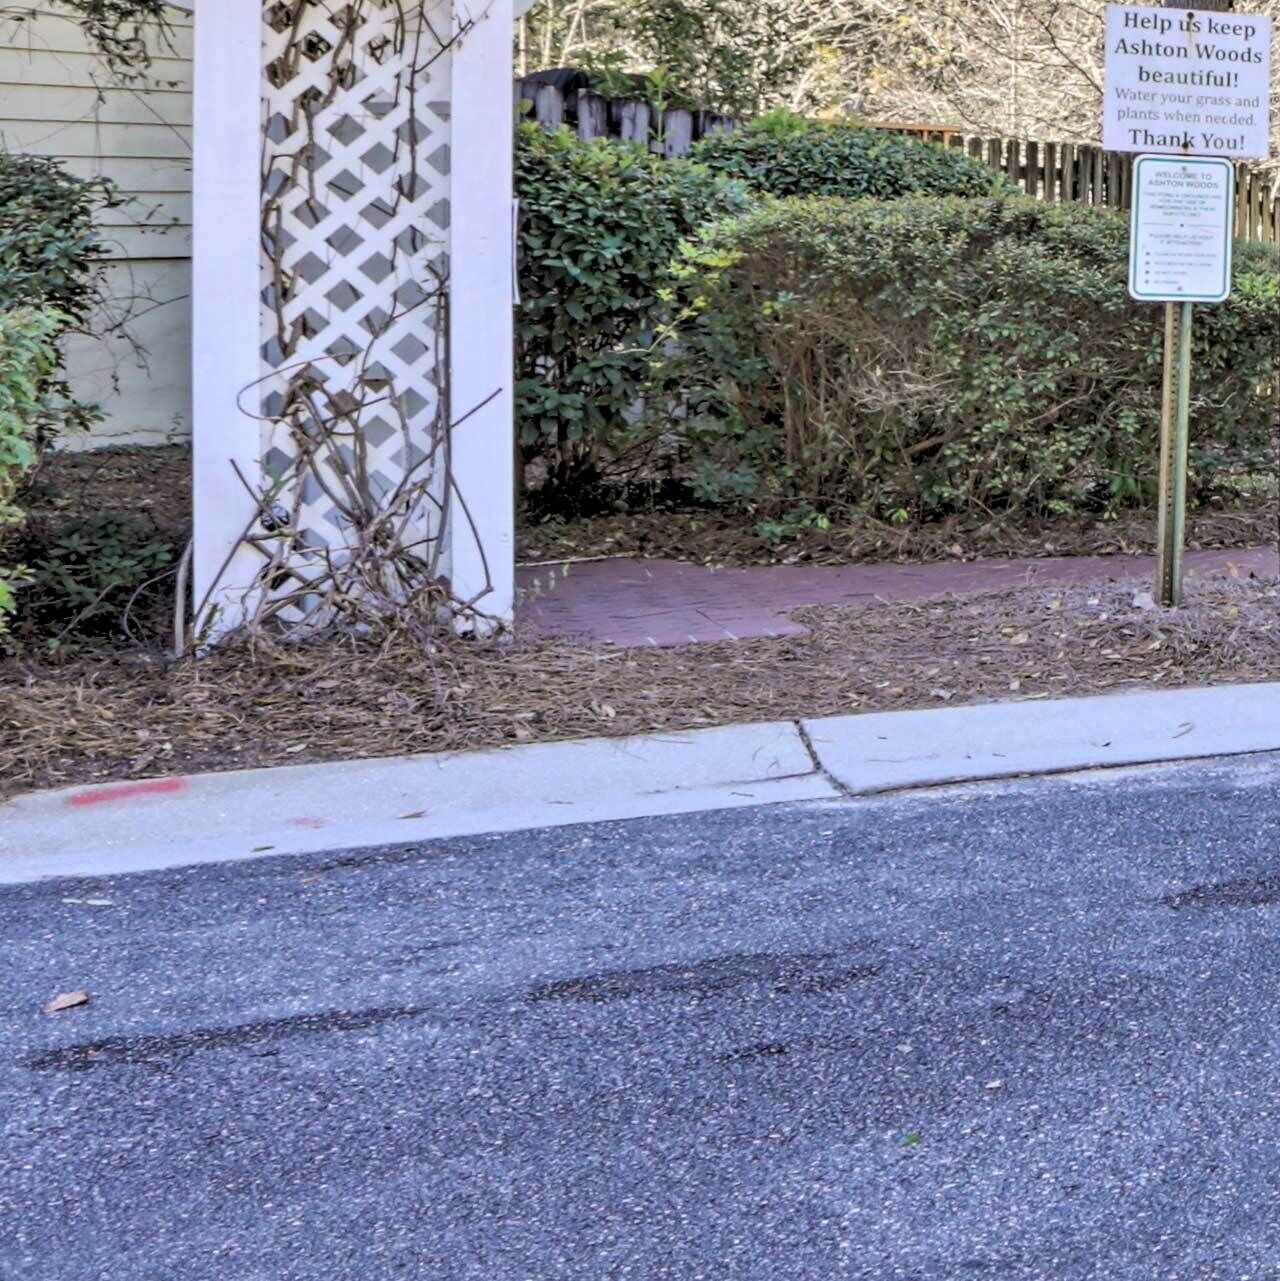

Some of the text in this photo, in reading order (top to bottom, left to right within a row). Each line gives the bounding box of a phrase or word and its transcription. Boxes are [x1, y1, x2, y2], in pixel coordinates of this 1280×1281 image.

[1124, 12, 1256, 41] Help us keep
[1114, 38, 1263, 64] Ashton Woods
[1138, 66, 1239, 88] beautiful!
[1115, 87, 1260, 108] Water your grass and
[1117, 107, 1160, 121] plants
[1163, 110, 1201, 123] when
[1128, 128, 1245, 151] Thank You!
[1147, 179, 1219, 189] ASHTON WOODS
[1155, 171, 1212, 181] WELCOME TO
